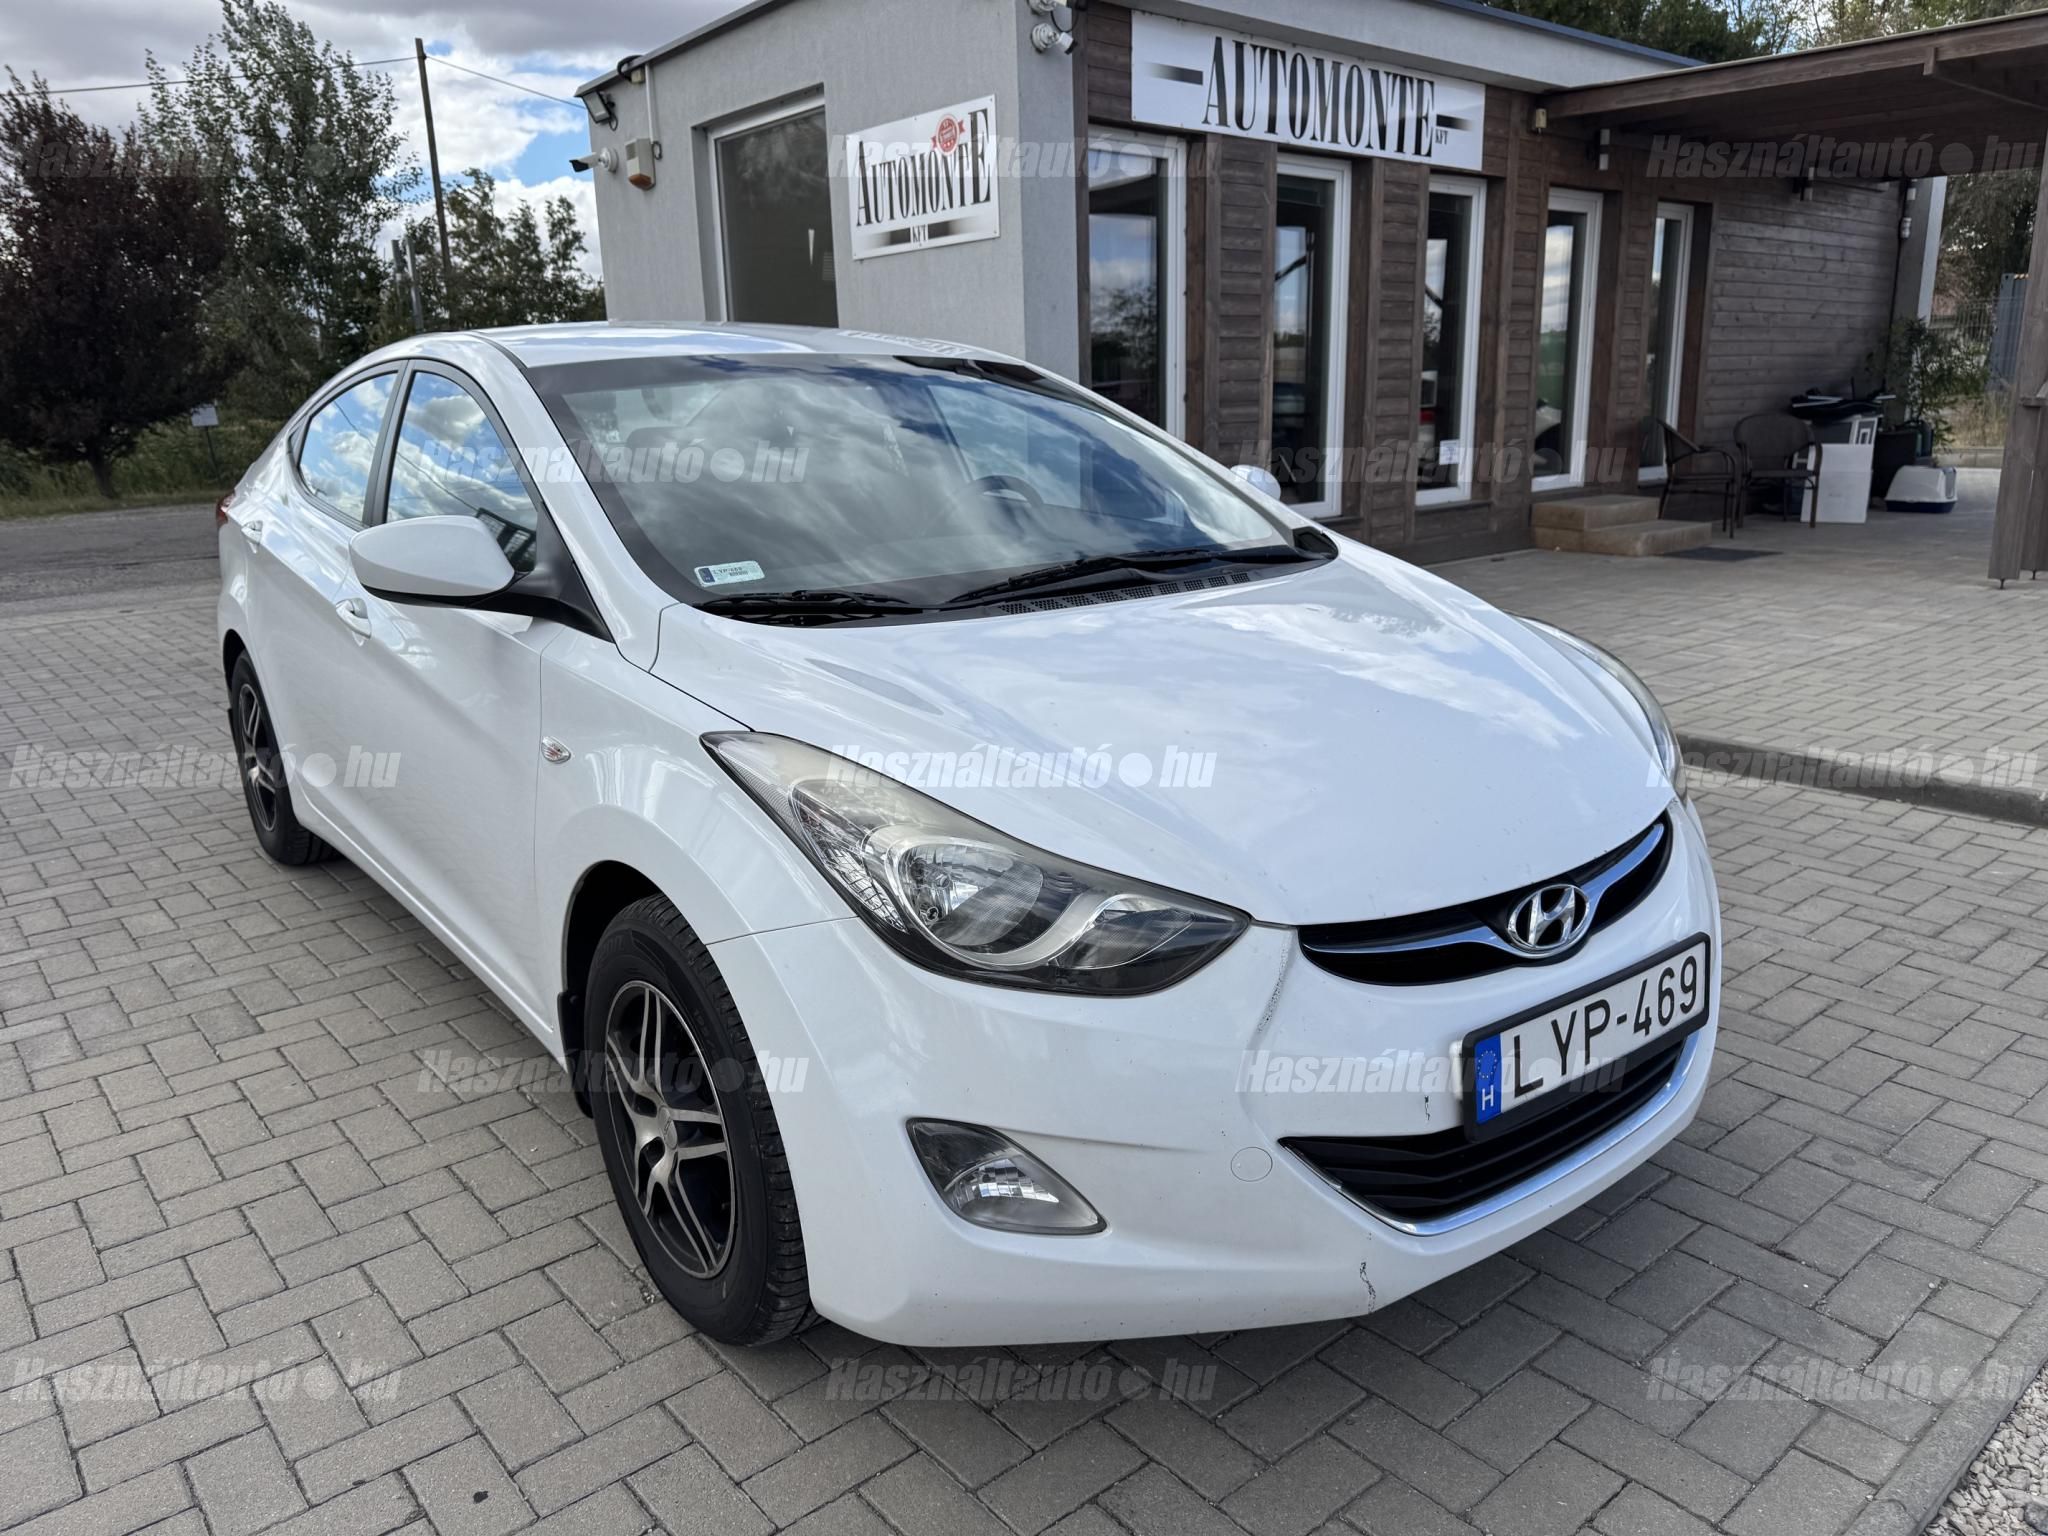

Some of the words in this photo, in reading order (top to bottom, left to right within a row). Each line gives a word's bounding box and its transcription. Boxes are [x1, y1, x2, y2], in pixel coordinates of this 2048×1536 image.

[1202, 37, 1434, 158] AUTOMONTE
[1435, 129, 1448, 145] KFT
[857, 108, 991, 227] AUTOMONTE
[1513, 955, 1699, 1098] LYP-469
[1481, 1085, 1495, 1111] H
